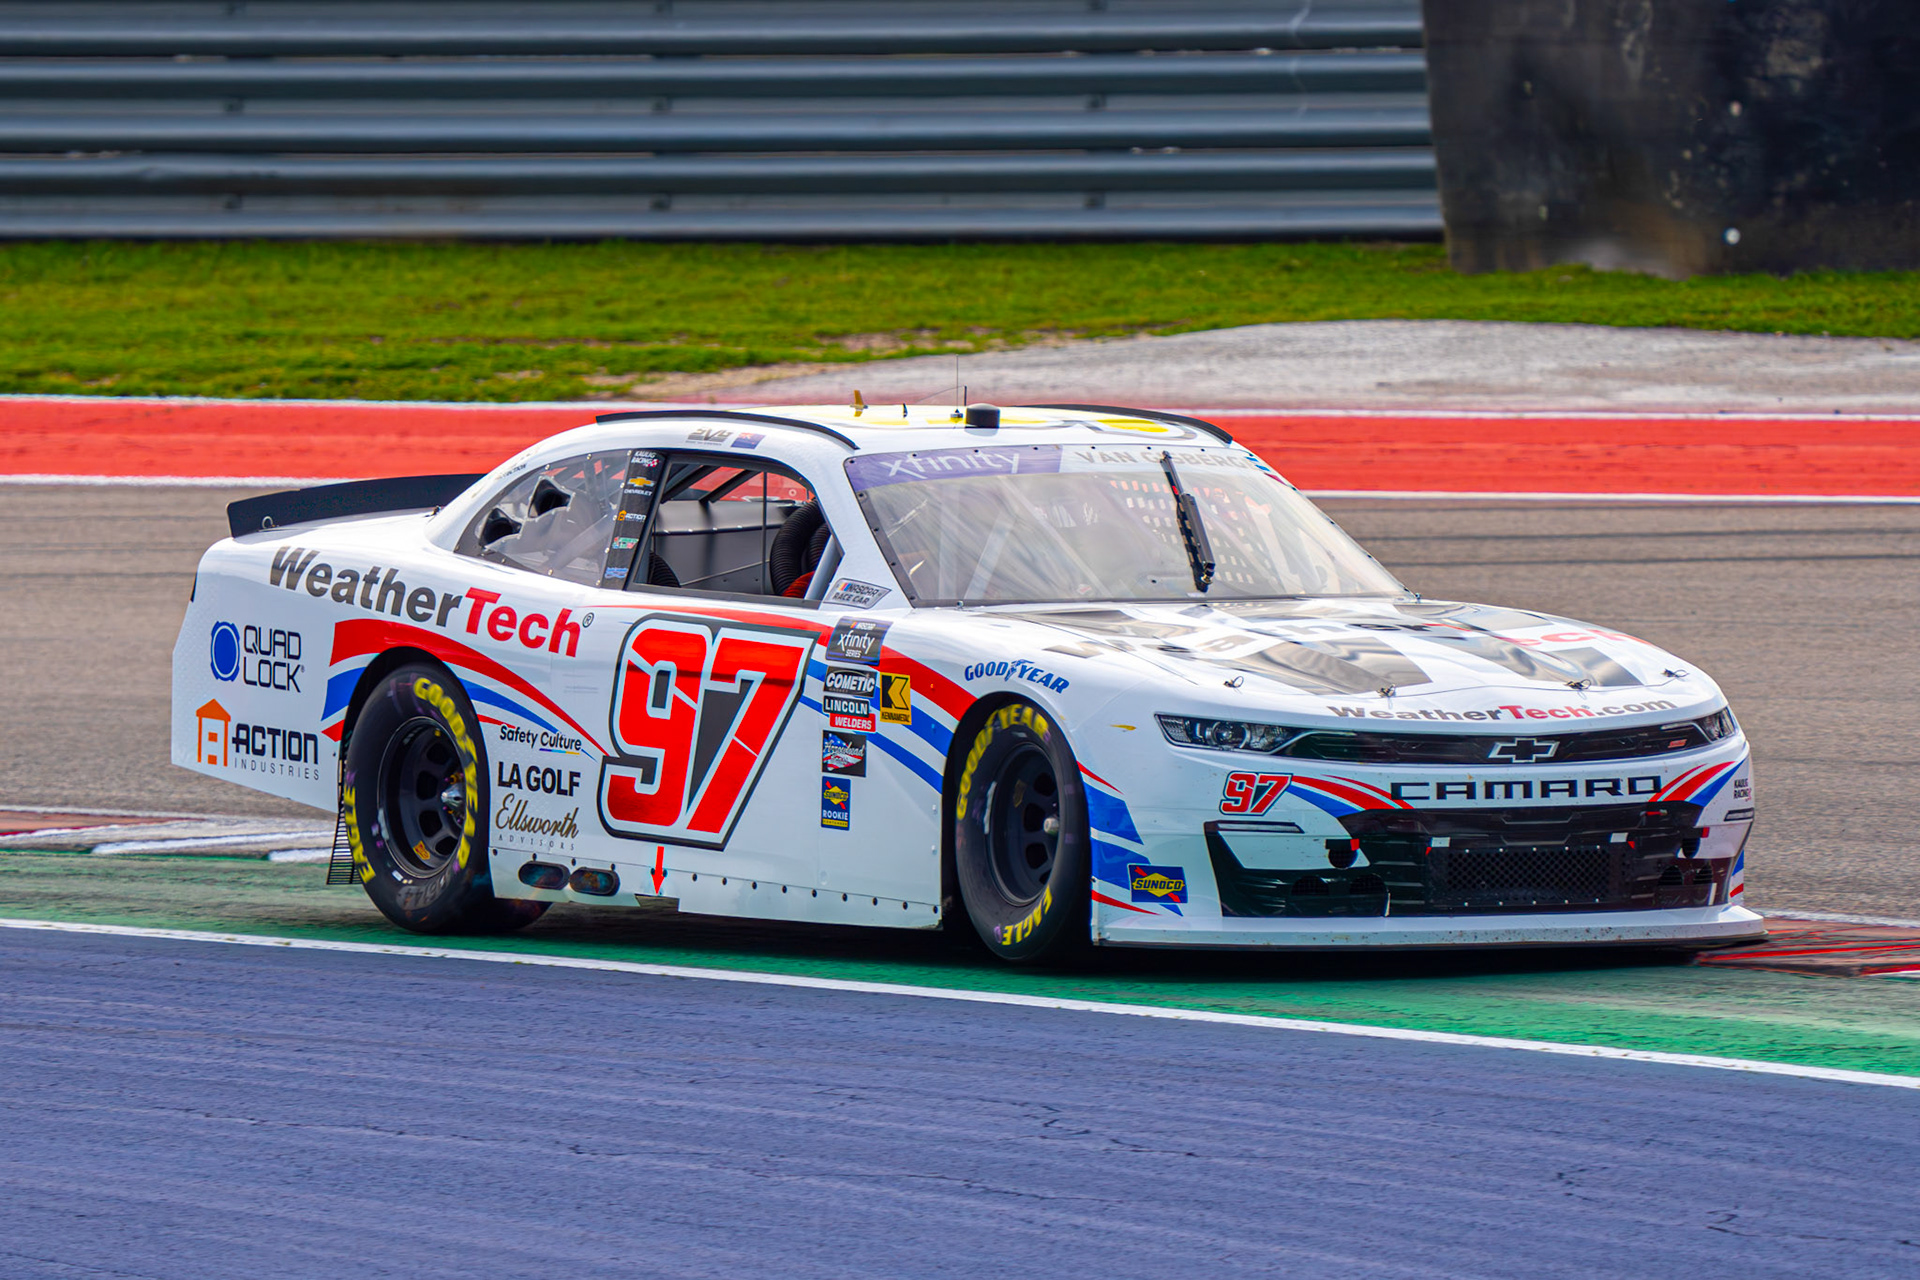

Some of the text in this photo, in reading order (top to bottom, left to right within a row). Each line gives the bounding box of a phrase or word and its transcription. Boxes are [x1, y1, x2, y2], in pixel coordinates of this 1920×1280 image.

[879, 452, 1020, 480] xfinity
[1074, 451, 1138, 464] VAN
[832, 592, 870, 604] RACE CAR
[847, 583, 880, 597] NASCAR
[243, 624, 302, 660] QUAD
[837, 630, 876, 655] xfinity
[845, 649, 862, 658] SERIES
[826, 672, 875, 693] COMETIC
[825, 698, 868, 715] LINCOLN
[600, 617, 815, 845] 97
[835, 716, 872, 730] WELDERS
[232, 722, 319, 765] ACTION
[500, 725, 582, 751] Safety Culture
[234, 757, 320, 781] INDUSTRIES
[497, 761, 581, 797] LA GOLF
[825, 791, 848, 800] SUNOCO
[1220, 771, 1292, 816] 97
[1390, 775, 1662, 801] CAMARO
[495, 793, 580, 839] Ellsworth
[822, 809, 848, 820] ROOKIE
[344, 784, 376, 884] EAGLE
[498, 834, 575, 851] ADVISORS
[1135, 879, 1182, 890] SUNOCO
[1002, 885, 1053, 946] EAGLE
